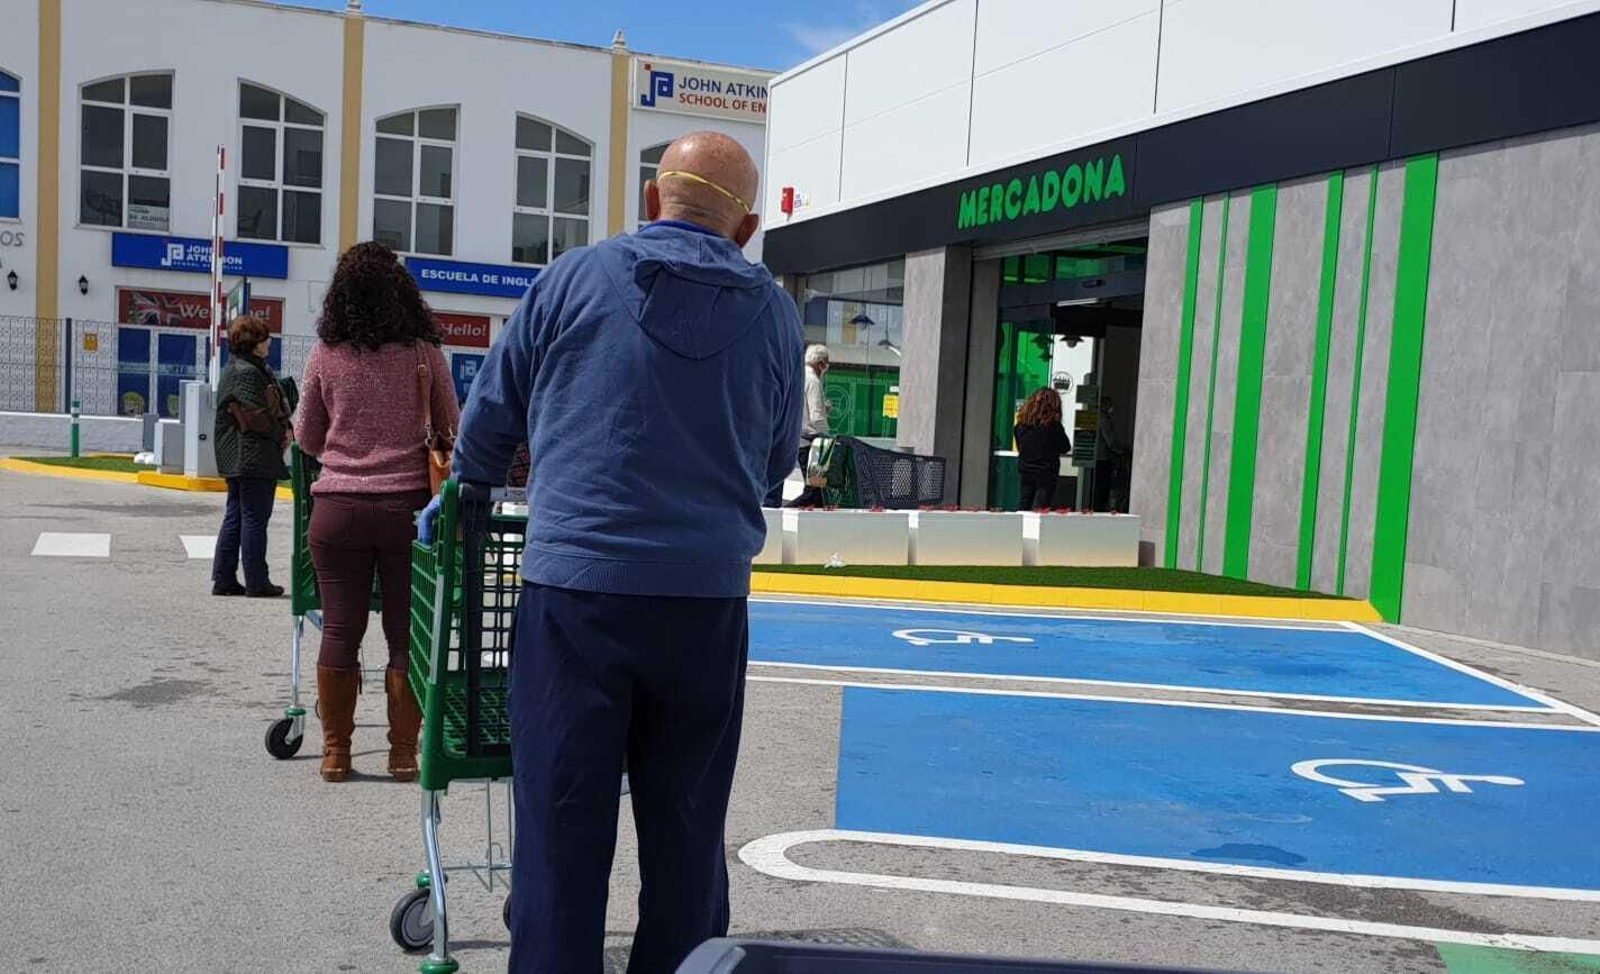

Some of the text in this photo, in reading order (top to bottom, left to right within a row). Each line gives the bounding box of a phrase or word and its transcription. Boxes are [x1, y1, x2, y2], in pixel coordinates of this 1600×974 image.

[678, 76, 722, 93] JOHN
[678, 92, 729, 110] SCHOOL
[732, 99, 749, 112] OF
[957, 153, 1126, 230] MERCADONA
[421, 268, 536, 287] ESCUELA DE INGL
[441, 322, 487, 337] Hello!
